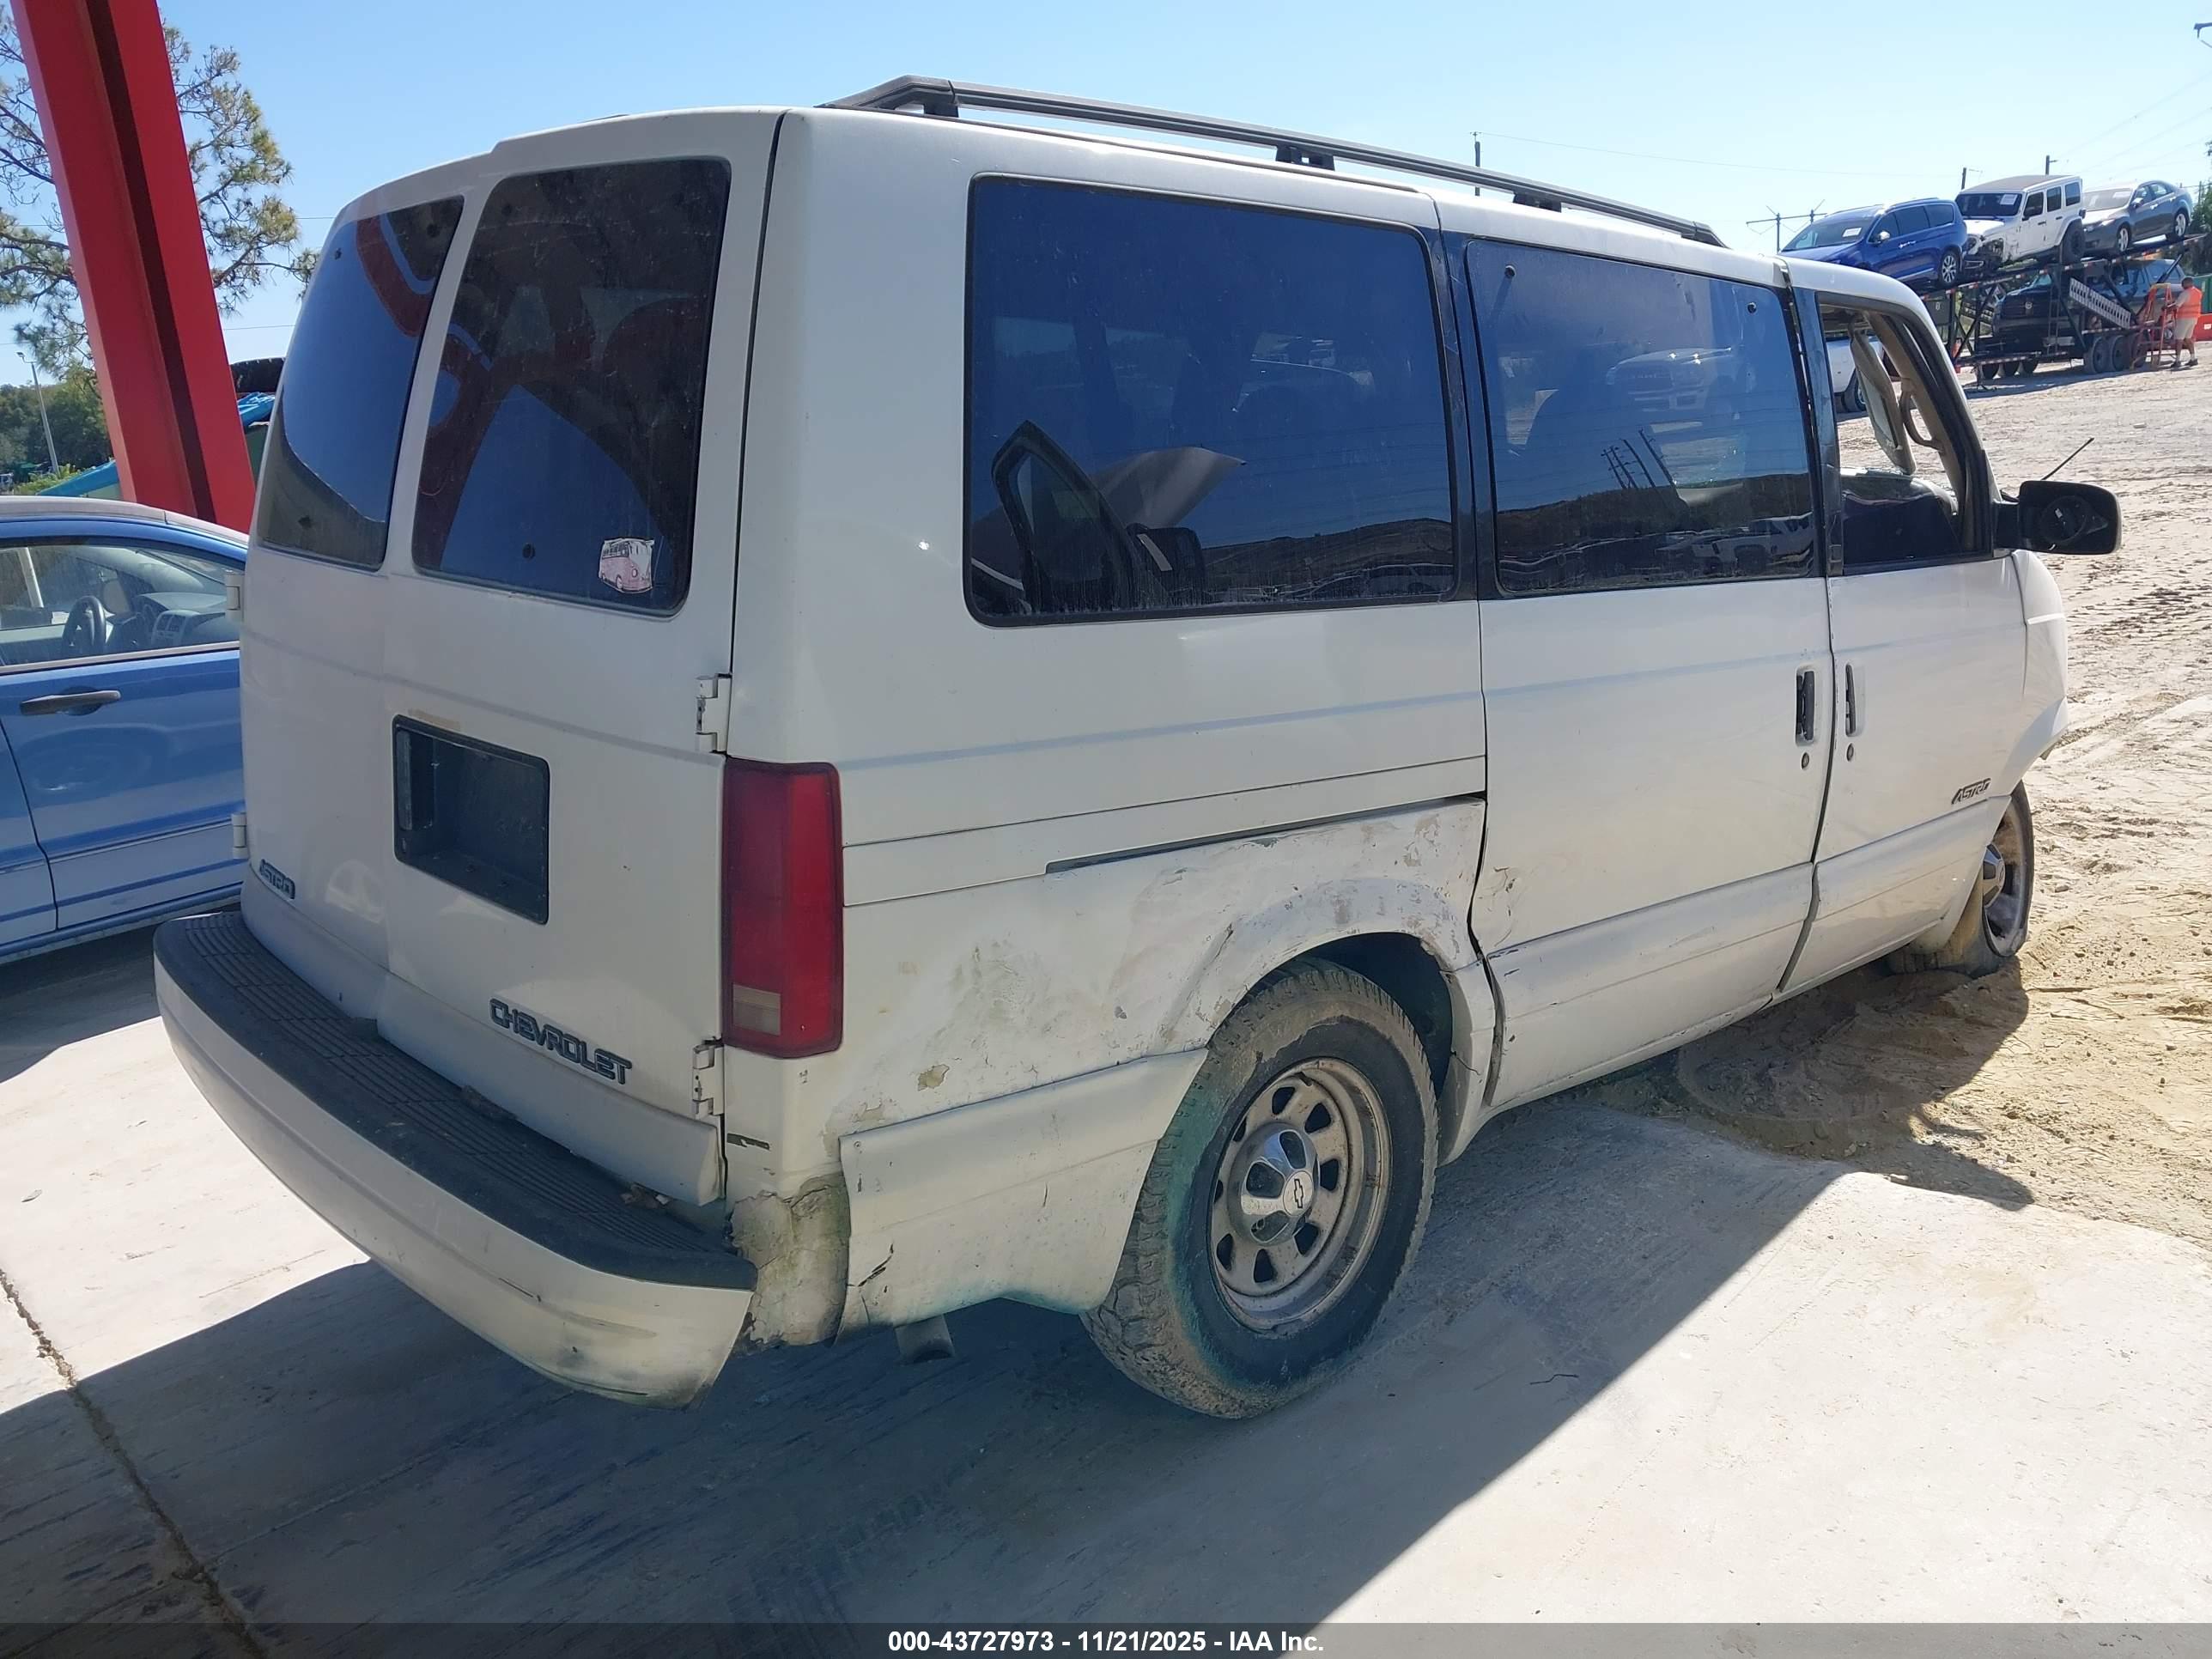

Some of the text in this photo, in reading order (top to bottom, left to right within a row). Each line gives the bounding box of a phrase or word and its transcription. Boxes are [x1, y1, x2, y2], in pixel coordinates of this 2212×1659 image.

[1951, 777, 1991, 805] ASTRO
[259, 859, 295, 900] ASTRO
[489, 998, 633, 1085] CHEVROLET
